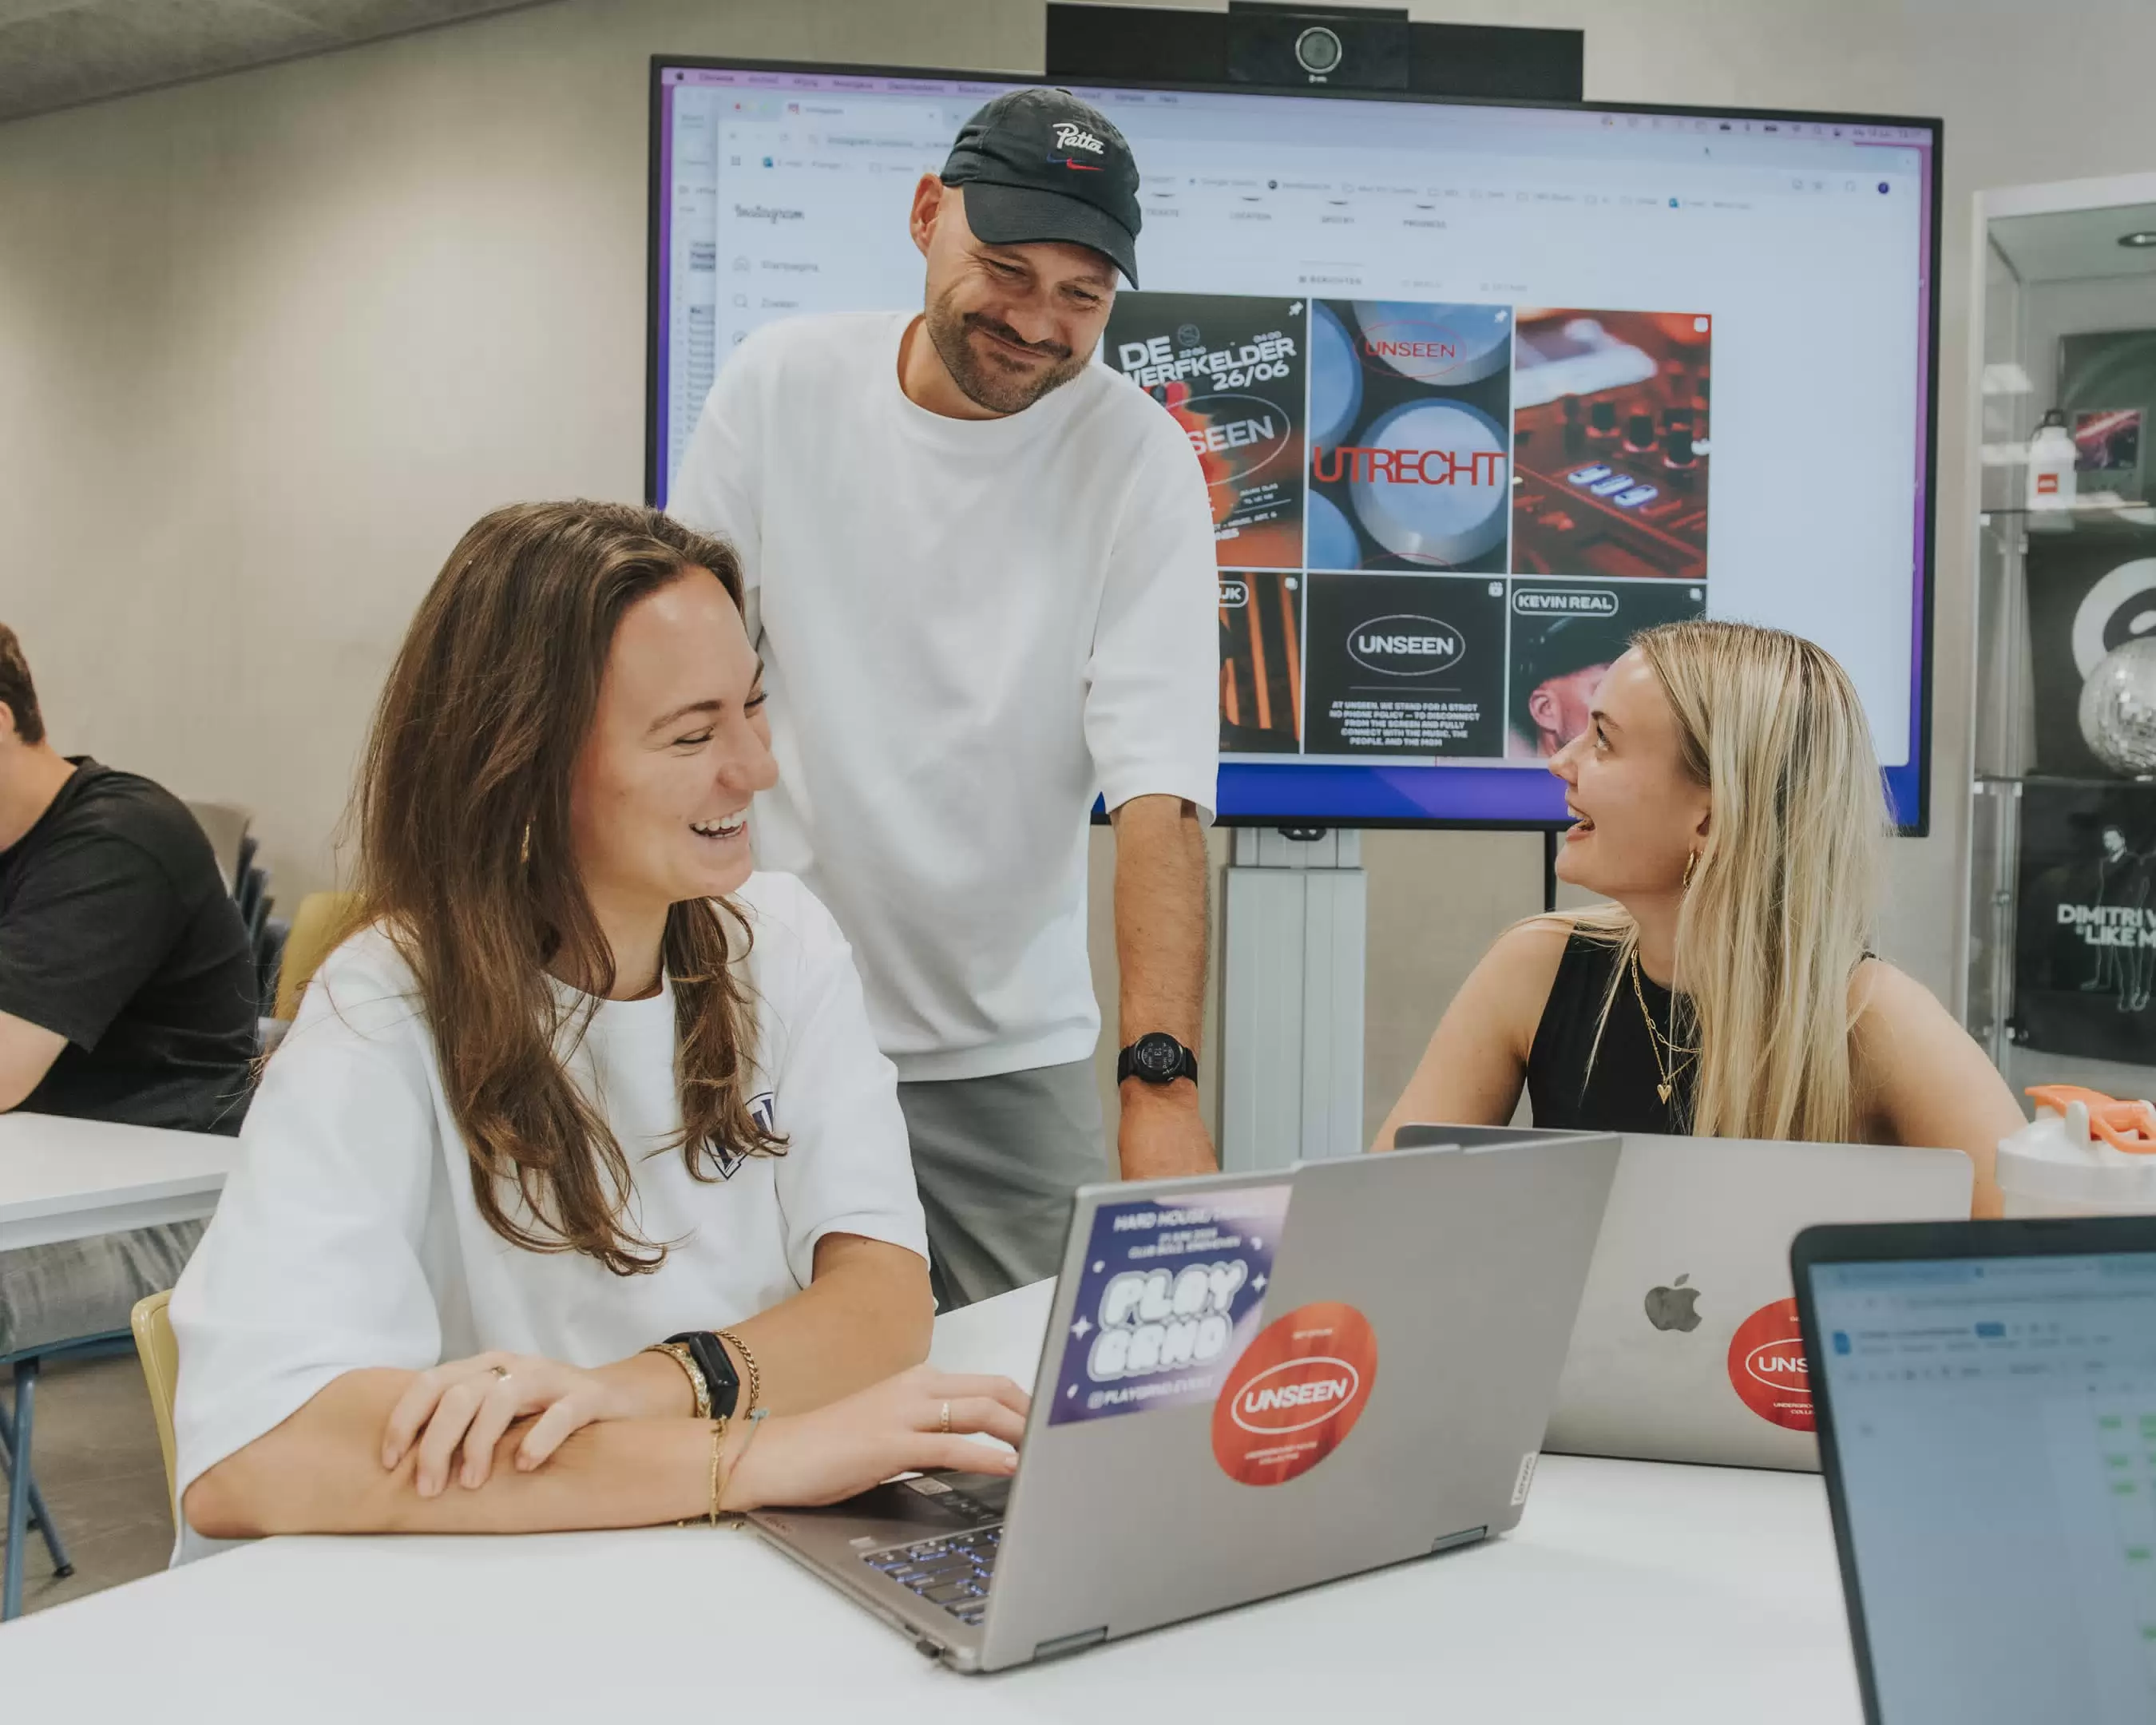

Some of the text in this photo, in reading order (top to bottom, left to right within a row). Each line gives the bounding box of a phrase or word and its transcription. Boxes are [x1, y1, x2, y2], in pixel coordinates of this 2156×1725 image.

[1052, 123, 1104, 154] Patta
[1119, 335, 1174, 371] DE
[1365, 341, 1456, 358] UNSEEN
[1211, 360, 1290, 391] 26/06
[1187, 415, 1275, 454] SEEN
[1313, 446, 1508, 486] UTRECHT
[1518, 594, 1612, 610] KEVIN REAL
[1357, 636, 1454, 655] UNSEEN
[2057, 904, 2143, 928] DIMITRI
[2085, 924, 2137, 948] LIKE
[1099, 1259, 1248, 1327] PLAY
[1758, 1356, 1809, 1374] UNS
[1245, 1378, 1348, 1414] UNSEEN
